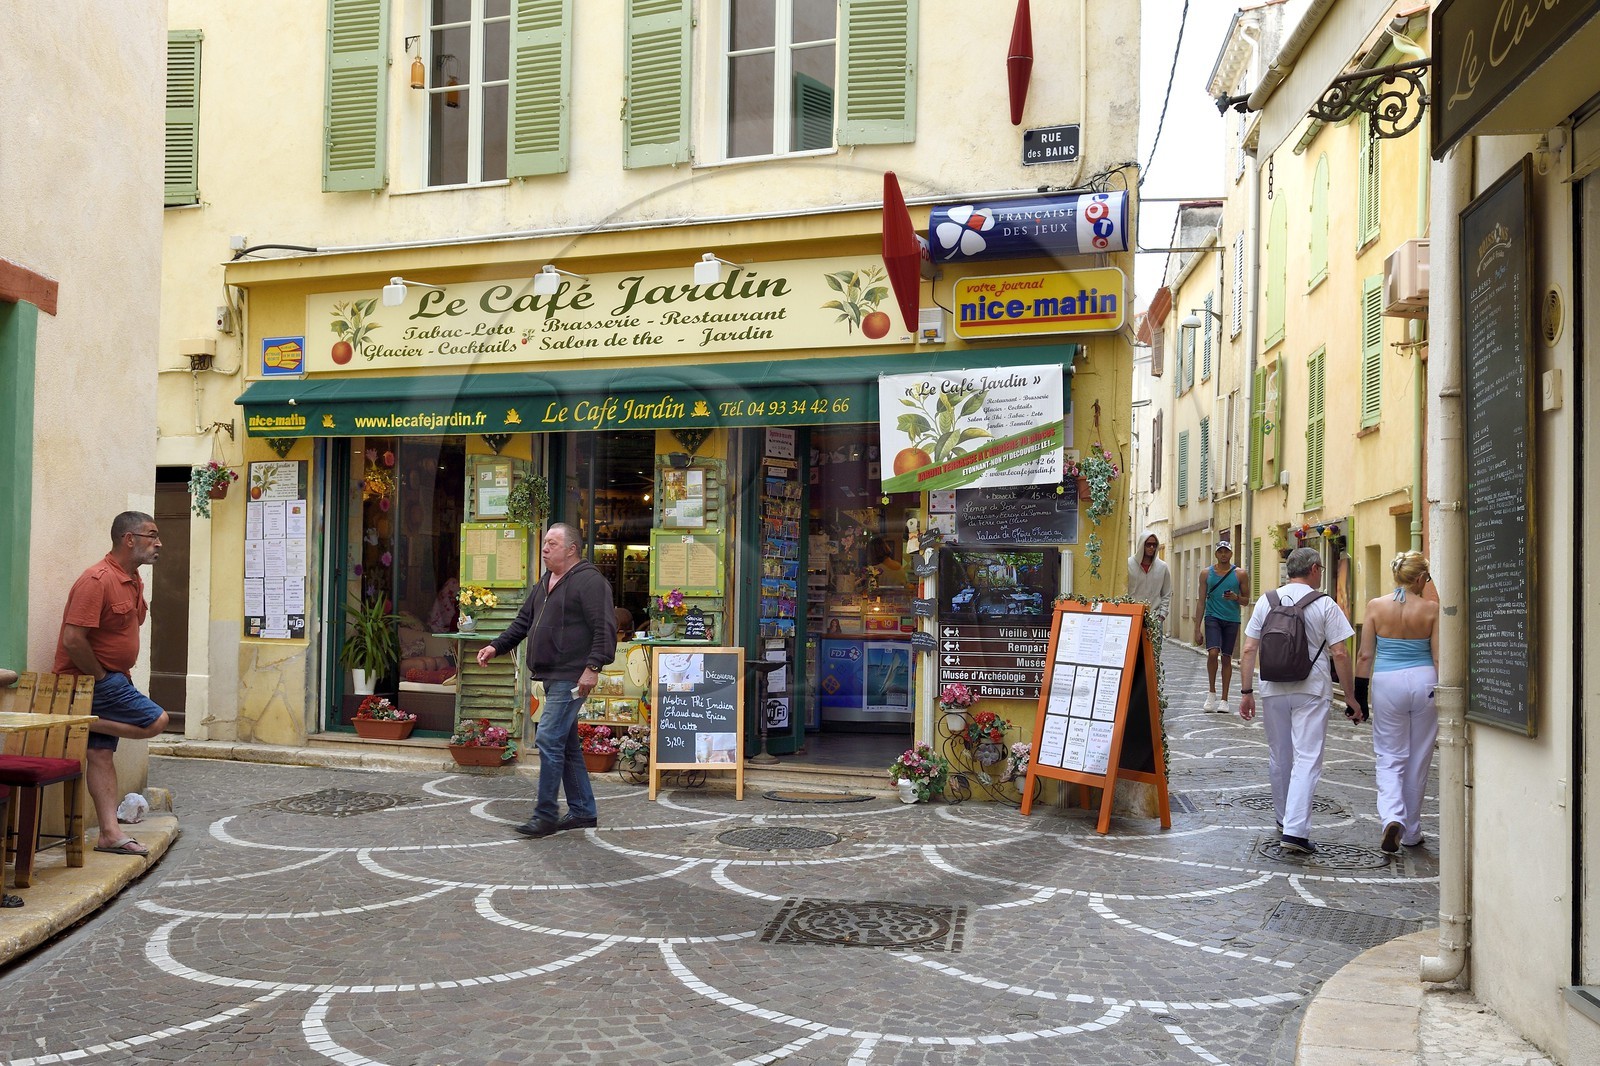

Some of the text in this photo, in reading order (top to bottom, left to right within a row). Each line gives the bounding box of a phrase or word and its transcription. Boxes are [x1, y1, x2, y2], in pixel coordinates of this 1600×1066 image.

[1447, 29, 1485, 110] Le
[1041, 132, 1061, 143] RUE
[1027, 145, 1075, 158] des BAINS
[998, 208, 1074, 222] FRANÇAISE
[1003, 223, 1068, 237] DES JEUX
[408, 268, 792, 321] Le Café Jardin
[966, 278, 1045, 297] votre journal
[960, 288, 1117, 322] nice-matin
[402, 323, 516, 341] Tabac-Loto
[541, 315, 641, 333] Brasserie
[662, 307, 788, 327] Restaurant
[363, 344, 424, 362] Glacier
[437, 340, 518, 356] Cocktails
[538, 335, 604, 351] Salon
[604, 333, 628, 348] de
[632, 331, 664, 346] the
[698, 326, 774, 347] Jardin
[918, 381, 937, 397] Le
[940, 377, 976, 398] Café
[979, 373, 1028, 395] Jardin
[986, 396, 1018, 405] Restaurant
[1023, 394, 1049, 402] Brasserie
[248, 415, 306, 428] nice-matin
[354, 411, 487, 431] www.lecafejardin.fr
[541, 401, 566, 424] Le
[583, 397, 619, 429] Café
[617, 394, 685, 425] Jardin
[747, 401, 765, 417] 04
[768, 400, 786, 416] 93
[789, 399, 807, 415] 34
[810, 398, 829, 414] 42
[832, 397, 850, 413] 66
[983, 406, 1003, 414] Glacier
[986, 422, 1004, 430] Jardin
[917, 465, 942, 483] JARDIN
[942, 454, 978, 473] TERRASSE
[1029, 427, 1056, 444] places
[1009, 444, 1041, 460] DECOUVREZ
[1035, 458, 1045, 466] 42
[1046, 457, 1056, 465] 66
[989, 465, 1056, 478] www.lecafejardin.fr
[962, 501, 988, 514] Longe
[1000, 500, 1018, 511] Porc
[976, 530, 1001, 541] Salade
[999, 627, 1051, 639] Vieille Ville
[830, 649, 846, 658] FDJ
[1007, 642, 1049, 655] Rempart
[1016, 656, 1046, 668] Musée
[942, 669, 1027, 683] Musée d'Archéologie
[980, 685, 1025, 698] Remparts
[662, 695, 735, 711] Notre Thé Indien
[663, 706, 691, 719] Chaud
